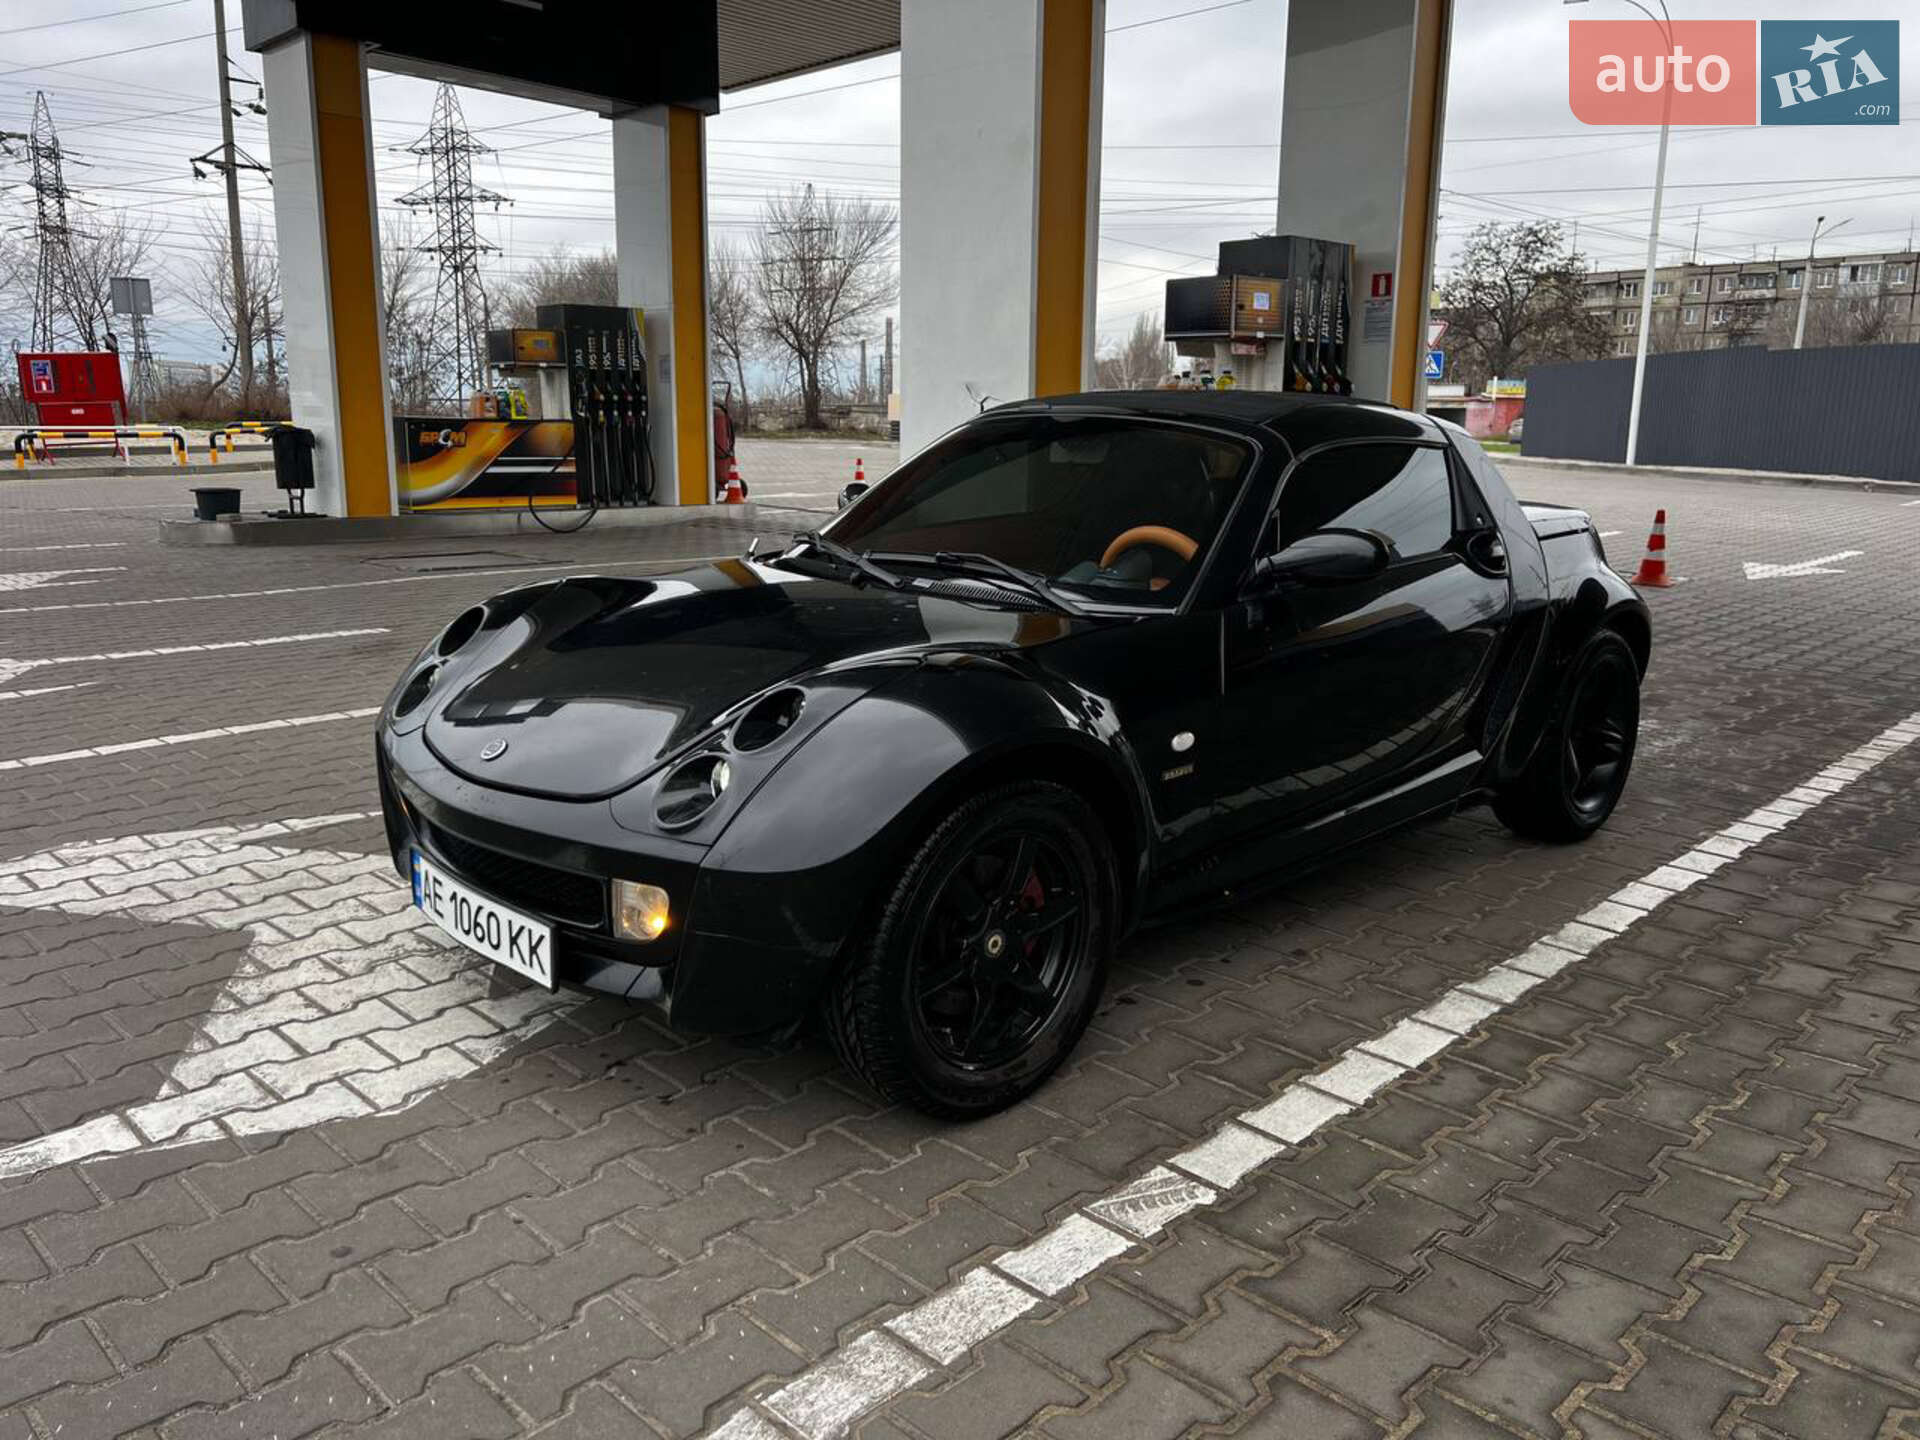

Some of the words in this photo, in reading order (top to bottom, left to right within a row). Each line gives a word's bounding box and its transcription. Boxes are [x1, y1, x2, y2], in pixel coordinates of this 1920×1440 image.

[424, 870, 444, 919] AE
[449, 891, 501, 950] 1060
[508, 919, 547, 976] KK
